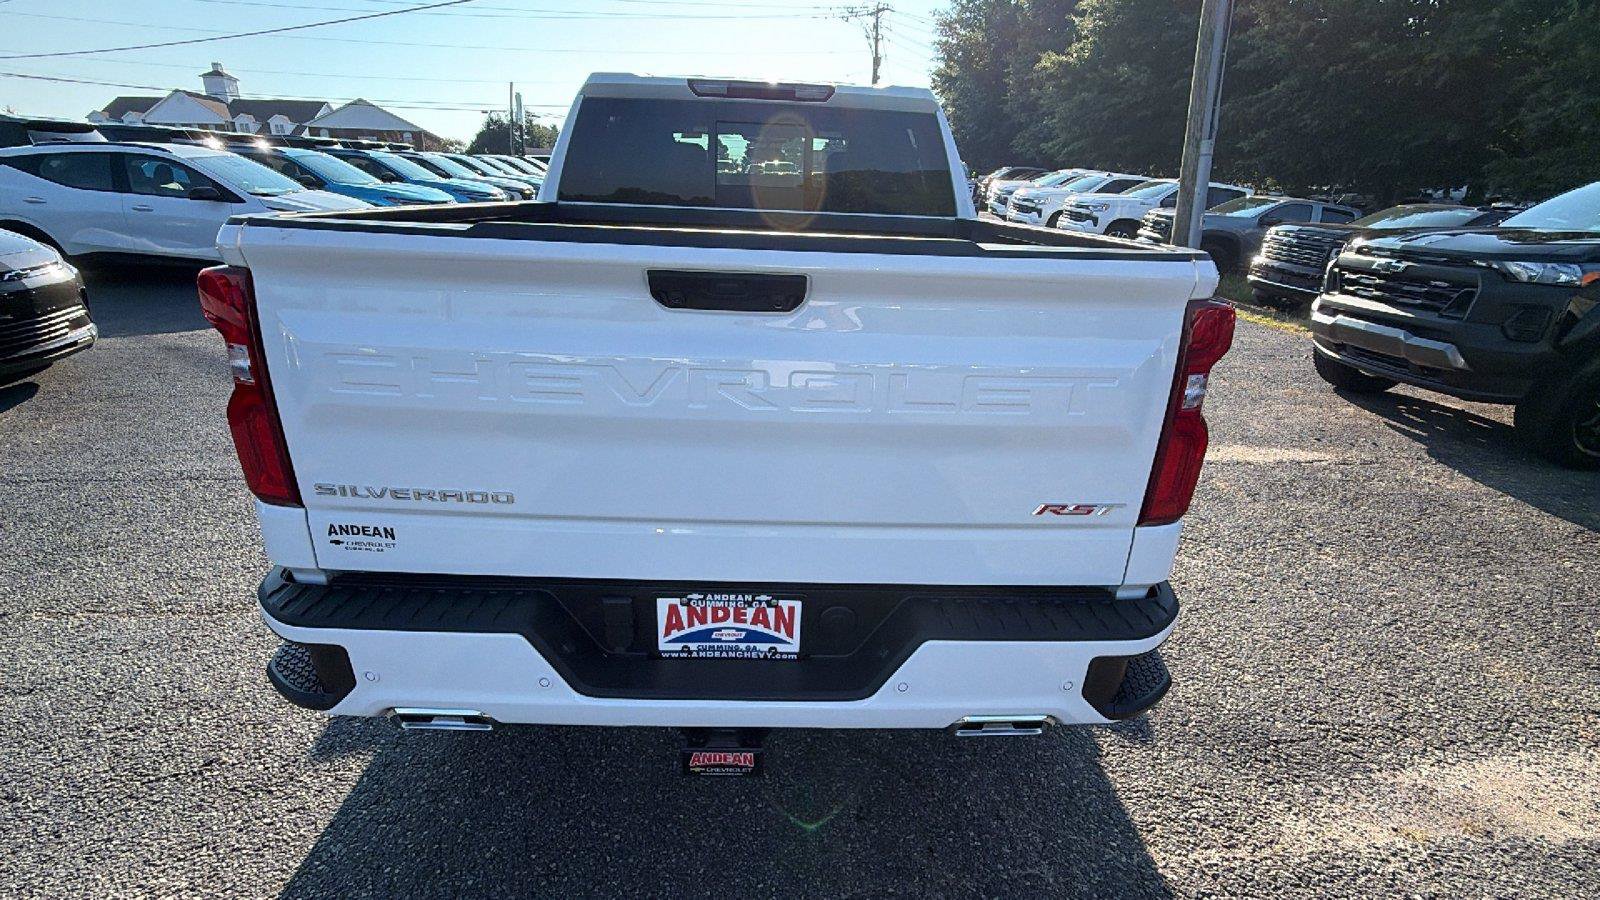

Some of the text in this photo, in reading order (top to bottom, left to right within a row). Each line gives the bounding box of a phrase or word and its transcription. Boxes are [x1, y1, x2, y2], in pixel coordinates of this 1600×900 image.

[323, 351, 1119, 416] CHEVROLET
[313, 482, 515, 505] SILVERADO
[1031, 503, 1127, 516] RST
[327, 523, 396, 541] ANDEAN
[346, 540, 397, 549] CHEVROLET
[690, 600, 749, 608] CUMMING,
[706, 593, 753, 601] ANDEAN
[663, 603, 796, 640] ANDEAN
[661, 651, 798, 660] www.ANDEANCHEVY.com
[689, 752, 755, 767] ANDEAN
